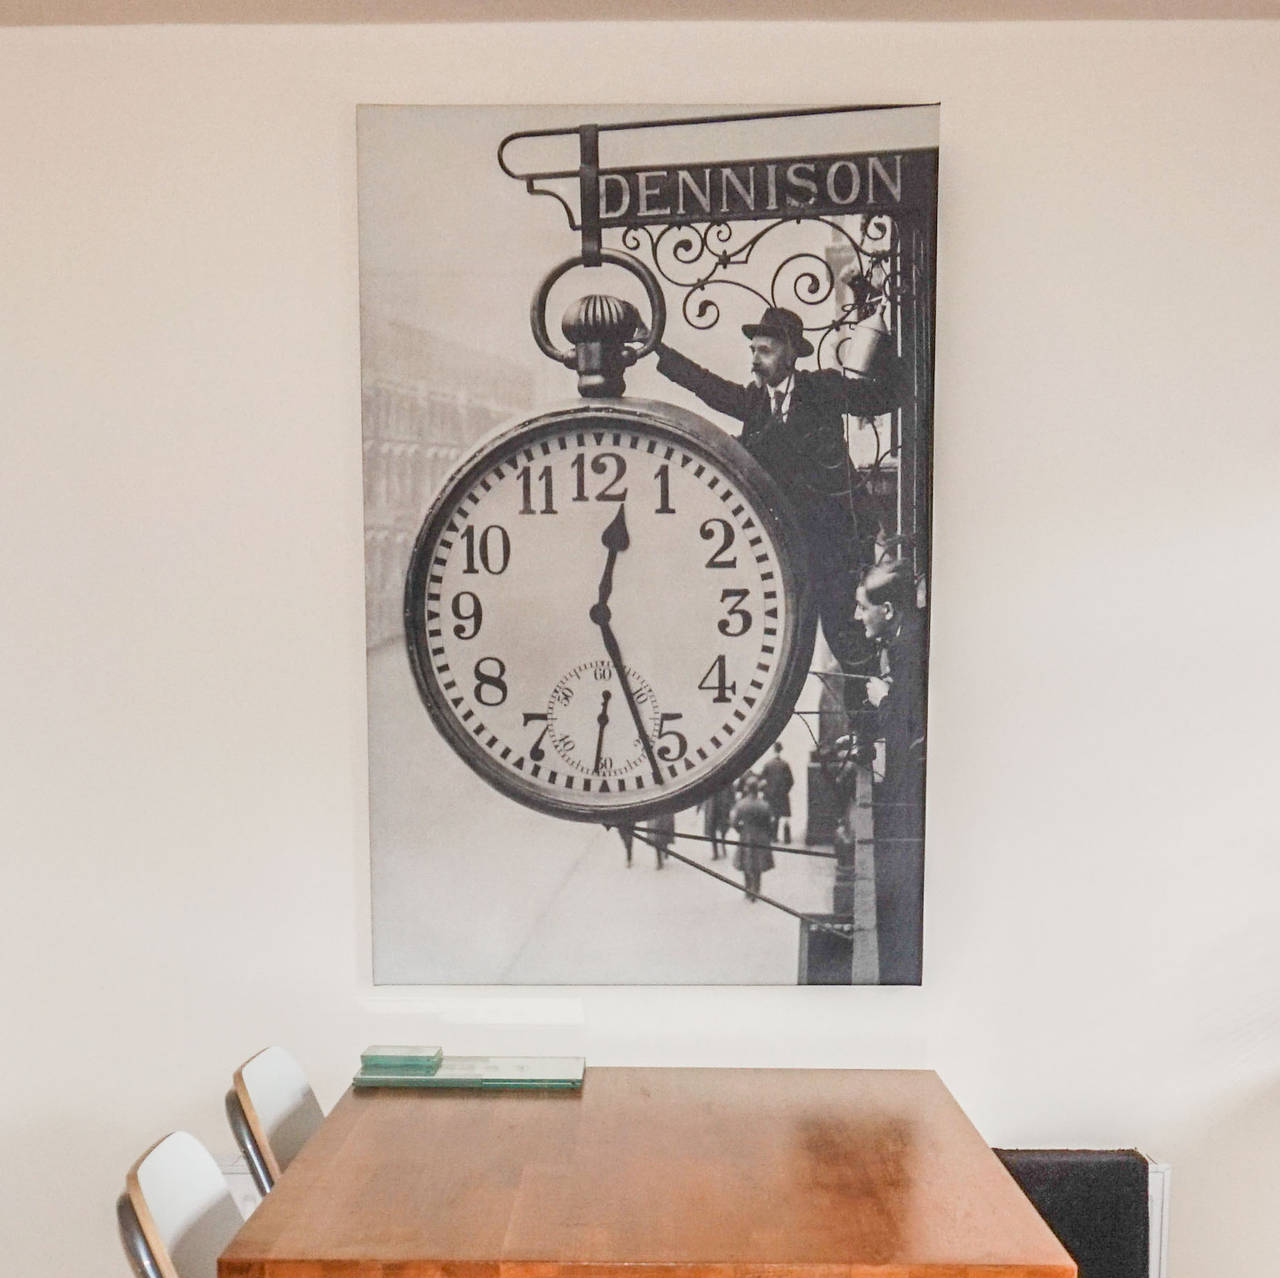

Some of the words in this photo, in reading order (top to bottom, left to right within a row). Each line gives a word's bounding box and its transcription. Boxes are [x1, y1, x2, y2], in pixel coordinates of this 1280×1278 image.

[598, 155, 904, 219] DENNISON
[517, 465, 557, 515] 11
[571, 453, 628, 502] 12
[654, 465, 676, 514] 1
[460, 525, 511, 575] 10
[699, 518, 737, 569] 2
[452, 592, 483, 640] 9
[717, 588, 753, 637] 3
[474, 657, 508, 706] 8
[594, 669, 612, 681] 60
[698, 655, 737, 703] 4
[523, 712, 549, 761] 7
[657, 712, 688, 762] 5
